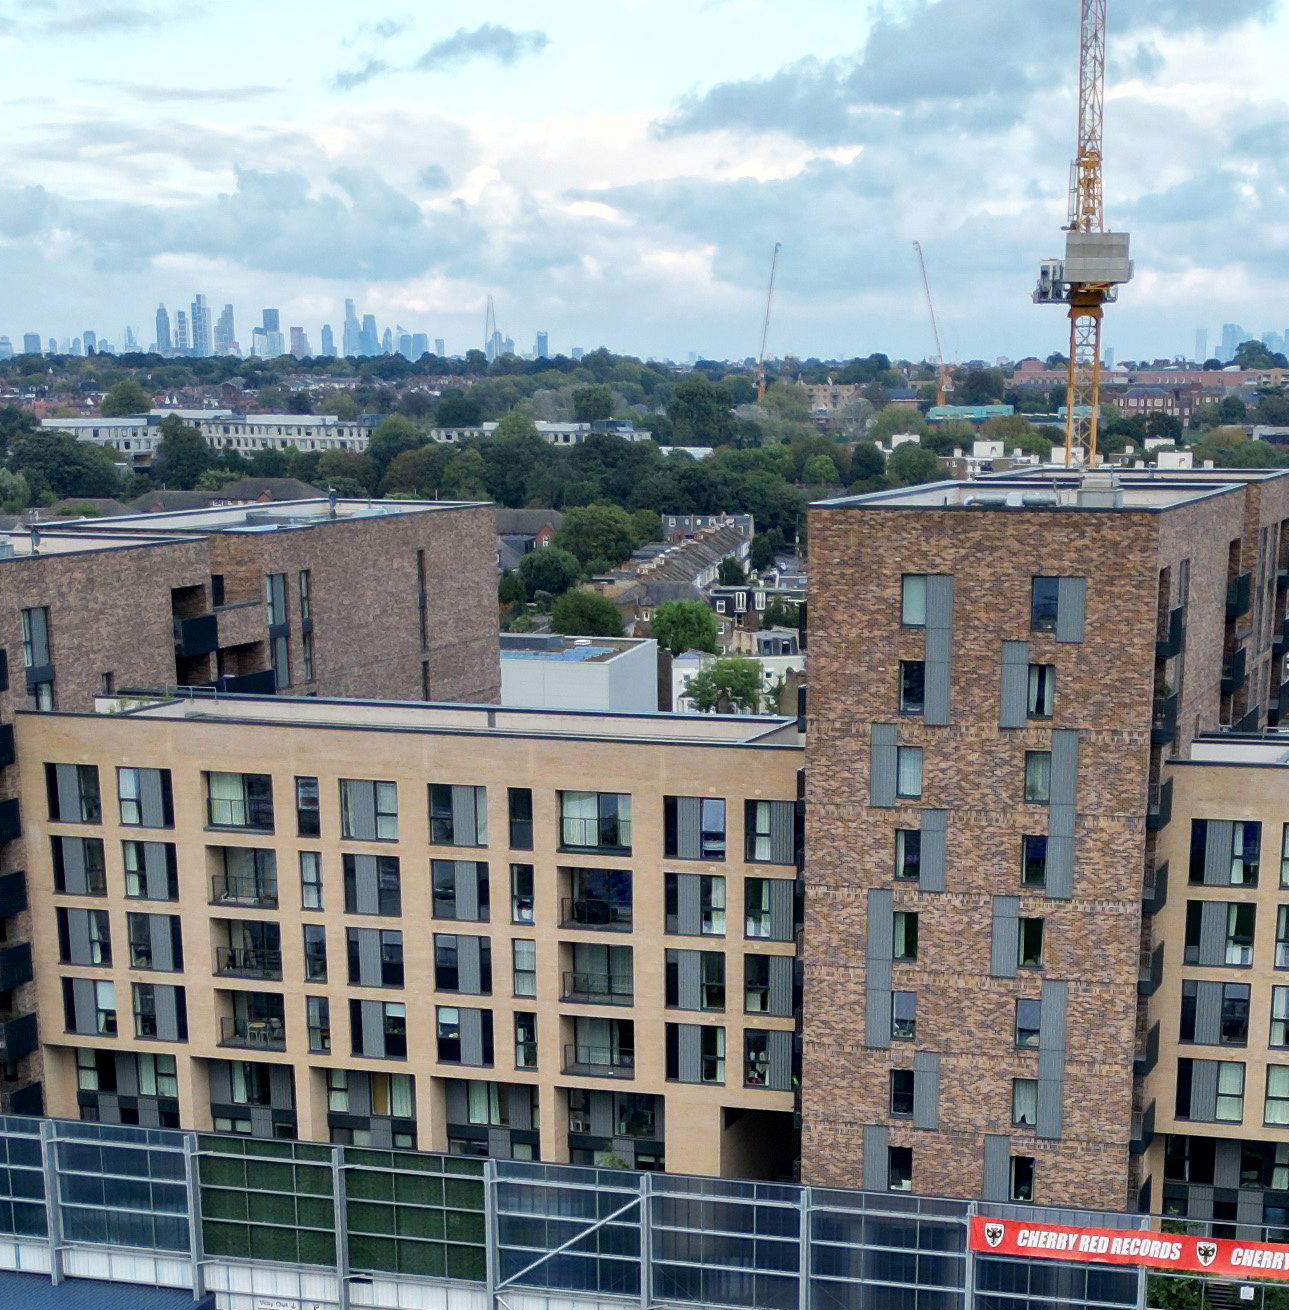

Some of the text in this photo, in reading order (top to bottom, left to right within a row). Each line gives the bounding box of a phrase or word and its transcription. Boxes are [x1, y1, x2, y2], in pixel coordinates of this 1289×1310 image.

[1017, 1229, 1182, 1260] CHERRY RED RECORDS
